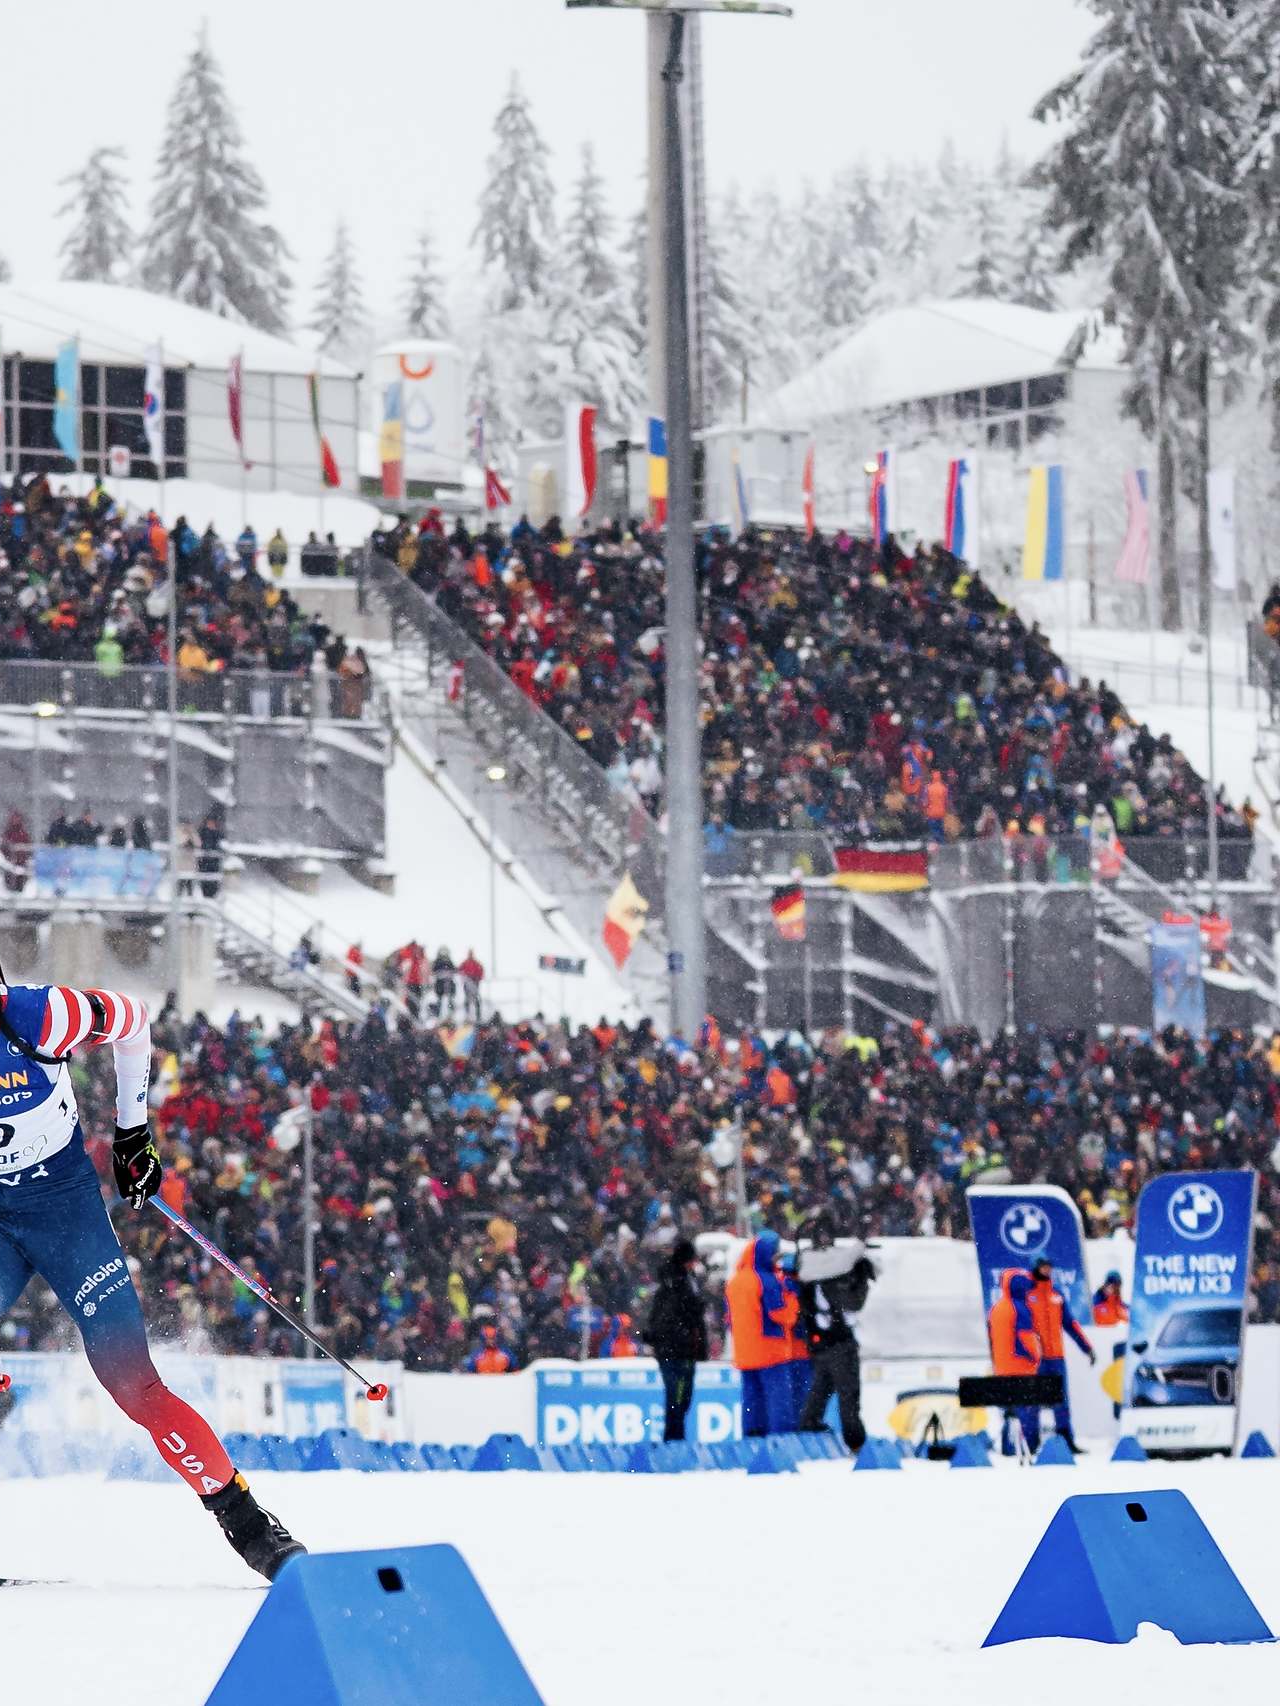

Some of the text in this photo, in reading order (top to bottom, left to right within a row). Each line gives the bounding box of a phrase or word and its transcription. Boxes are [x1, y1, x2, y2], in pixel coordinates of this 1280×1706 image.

[1143, 1254, 1237, 1275] THE NEW
[98, 1274, 131, 1302] ARIEN
[1143, 1275, 1195, 1296] BMW
[544, 1402, 646, 1447] DKB
[162, 1431, 223, 1495] USA
